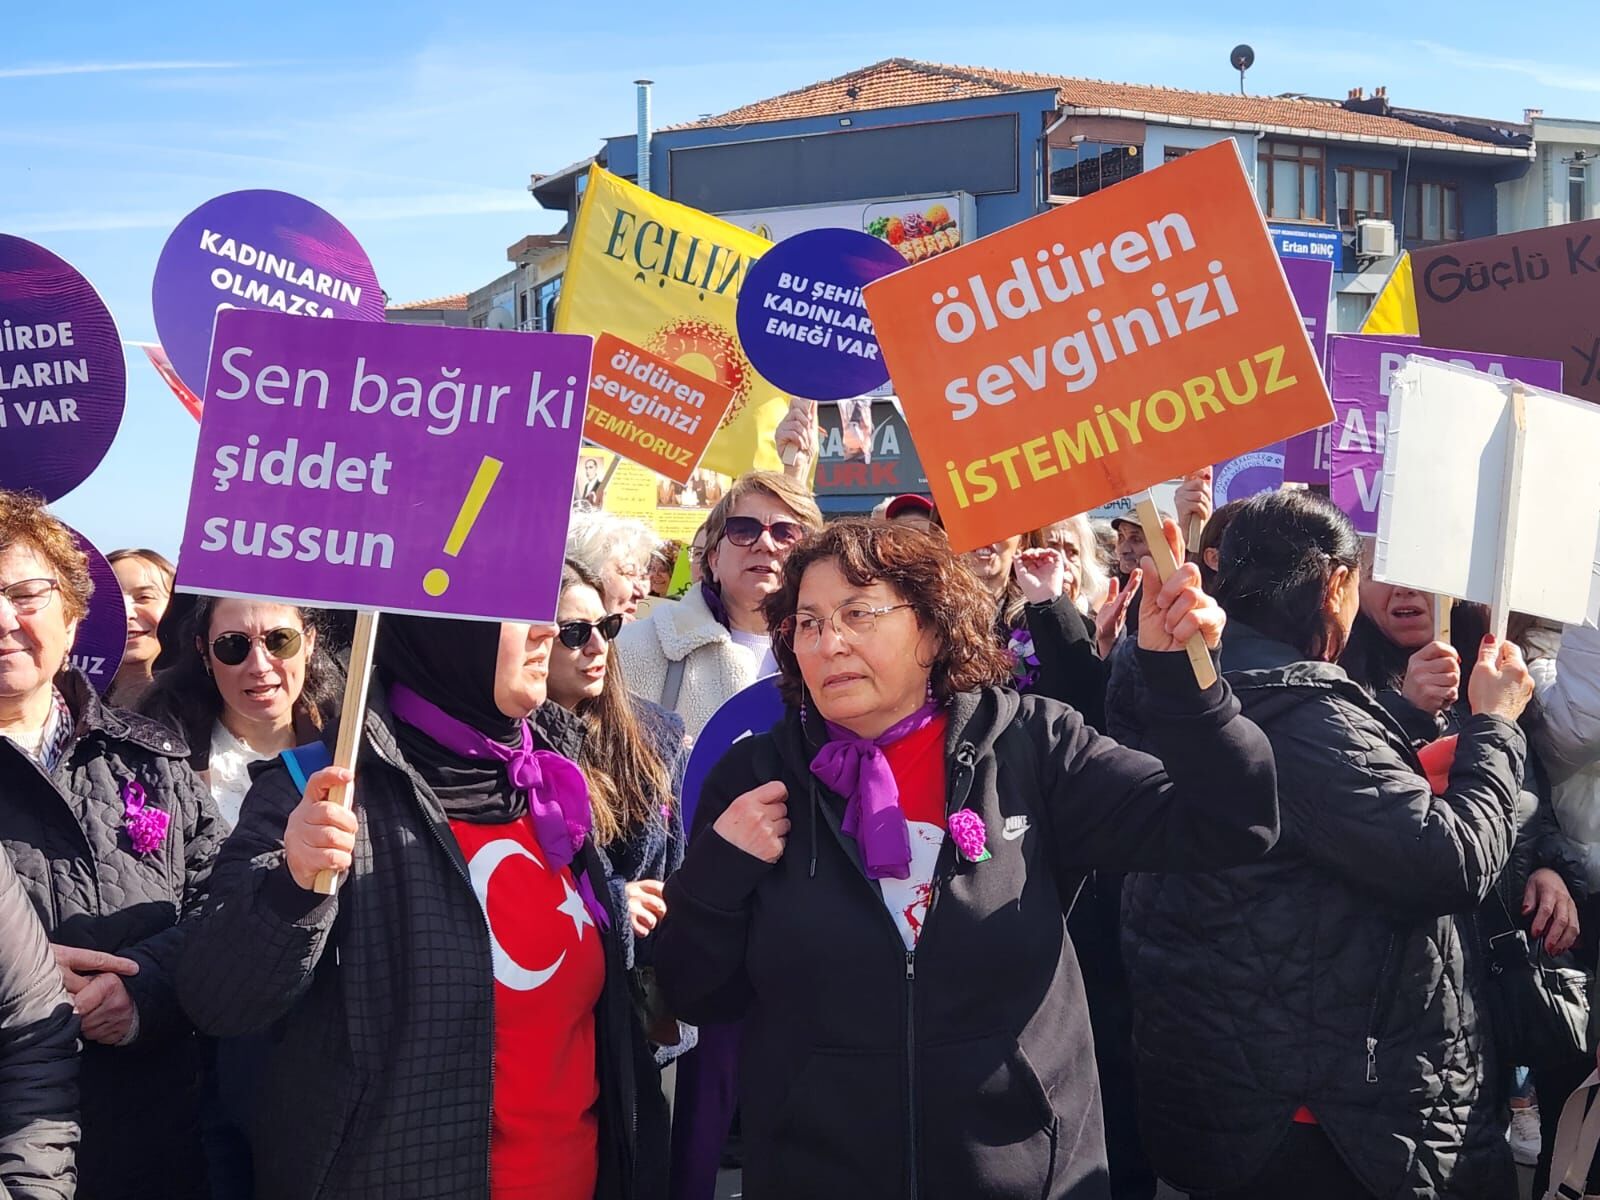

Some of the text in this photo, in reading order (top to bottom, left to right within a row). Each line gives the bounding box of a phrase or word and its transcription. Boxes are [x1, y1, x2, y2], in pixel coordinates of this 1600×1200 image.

[200, 229, 362, 306] KADINLARIN
[1282, 240, 1309, 254] Ertan
[1423, 246, 1549, 303] Güçlü
[778, 272, 808, 293] BU
[931, 212, 1197, 344] öldüren
[763, 292, 876, 336] KADINLAR
[765, 317, 879, 360] EMEĞİ VAR
[945, 260, 1239, 421] sevginizi
[215, 346, 577, 435] Sen bağır ki
[591, 374, 702, 436] sevginizi
[610, 349, 706, 409] öldüren
[13, 398, 81, 426] VAR
[946, 344, 1298, 509] İSTEMİYORUZ
[212, 434, 392, 495] şiddet
[200, 516, 394, 569] sussun
[1005, 815, 1028, 831] NIKE
